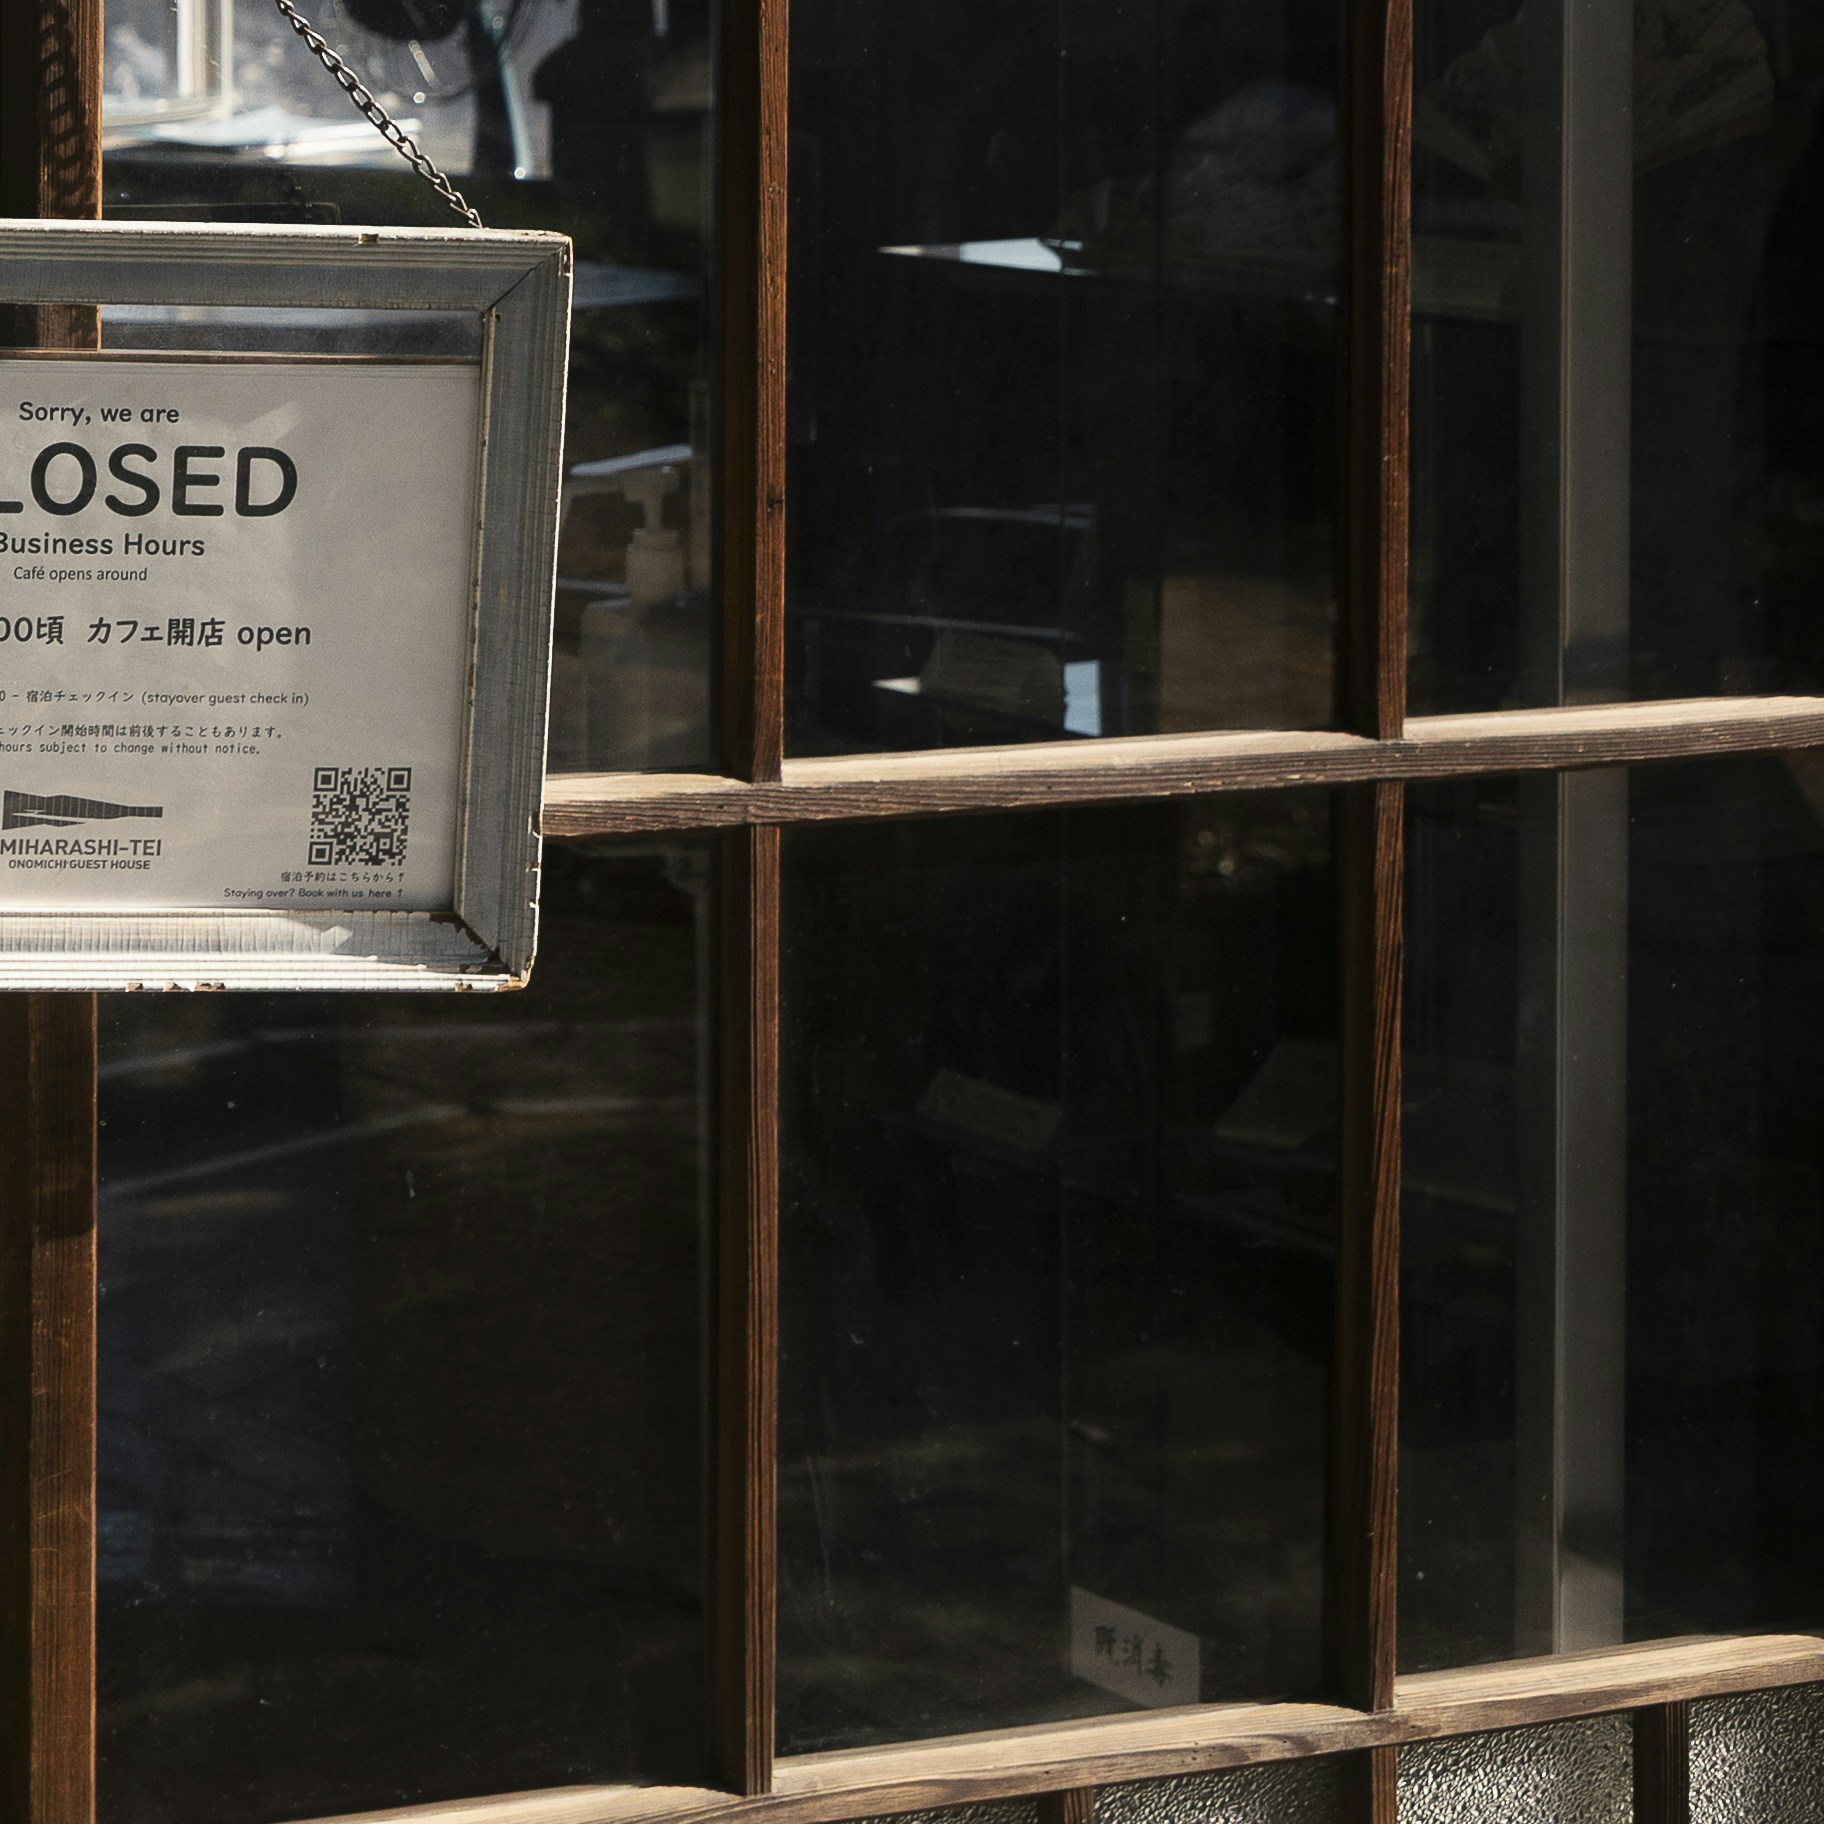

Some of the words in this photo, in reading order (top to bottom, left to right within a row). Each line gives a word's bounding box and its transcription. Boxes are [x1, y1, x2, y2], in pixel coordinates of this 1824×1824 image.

[19, 401, 91, 426] Sorry,
[101, 406, 132, 423] we
[140, 407, 180, 424] are
[123, 533, 205, 557] Hours
[13, 566, 45, 581] Café
[49, 568, 92, 583] opens
[97, 567, 148, 582] around
[87, 617, 226, 647] カフェ開店
[237, 623, 312, 652] open
[26, 689, 135, 704] 宿泊チェックイン
[141, 691, 205, 706] (stayover
[208, 693, 245, 707] guest
[249, 690, 288, 705] check
[290, 691, 310, 706] in)
[39, 740, 87, 756] subject
[94, 741, 107, 753] to
[113, 741, 155, 757] change
[160, 742, 209, 754] without
[214, 742, 260, 755] notice.
[0, 838, 162, 857] MIHARASHI-TEI
[8, 859, 68, 870] ONOMICHI
[69, 859, 108, 870] GUEST
[110, 859, 150, 870] HOUSE
[224, 888, 263, 899] Staying
[266, 888, 295, 899] over?
[298, 888, 324, 898] Book
[326, 888, 349, 898] with
[351, 890, 364, 898] us
[368, 888, 392, 898] here
